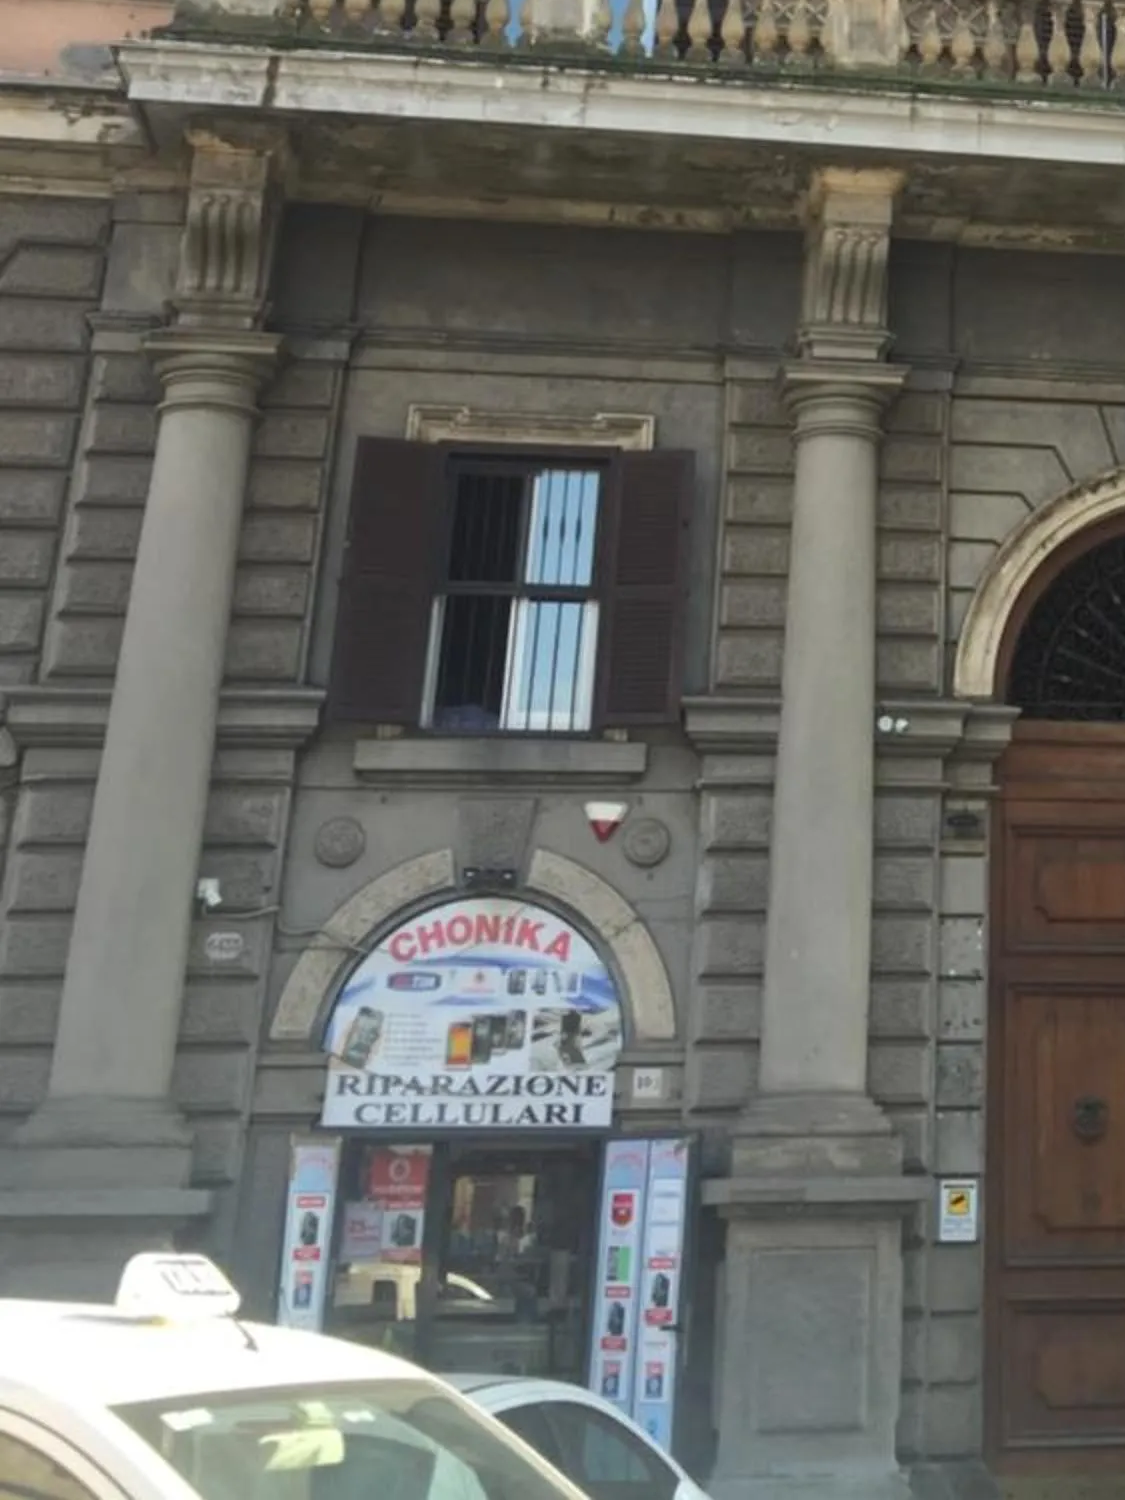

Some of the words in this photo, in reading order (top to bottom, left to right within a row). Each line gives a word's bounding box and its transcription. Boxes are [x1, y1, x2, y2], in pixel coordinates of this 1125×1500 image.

[388, 914, 572, 963] CHONIKA
[335, 1073, 608, 1097] RIPARAZIONE
[353, 1102, 586, 1125] CELLULARI
